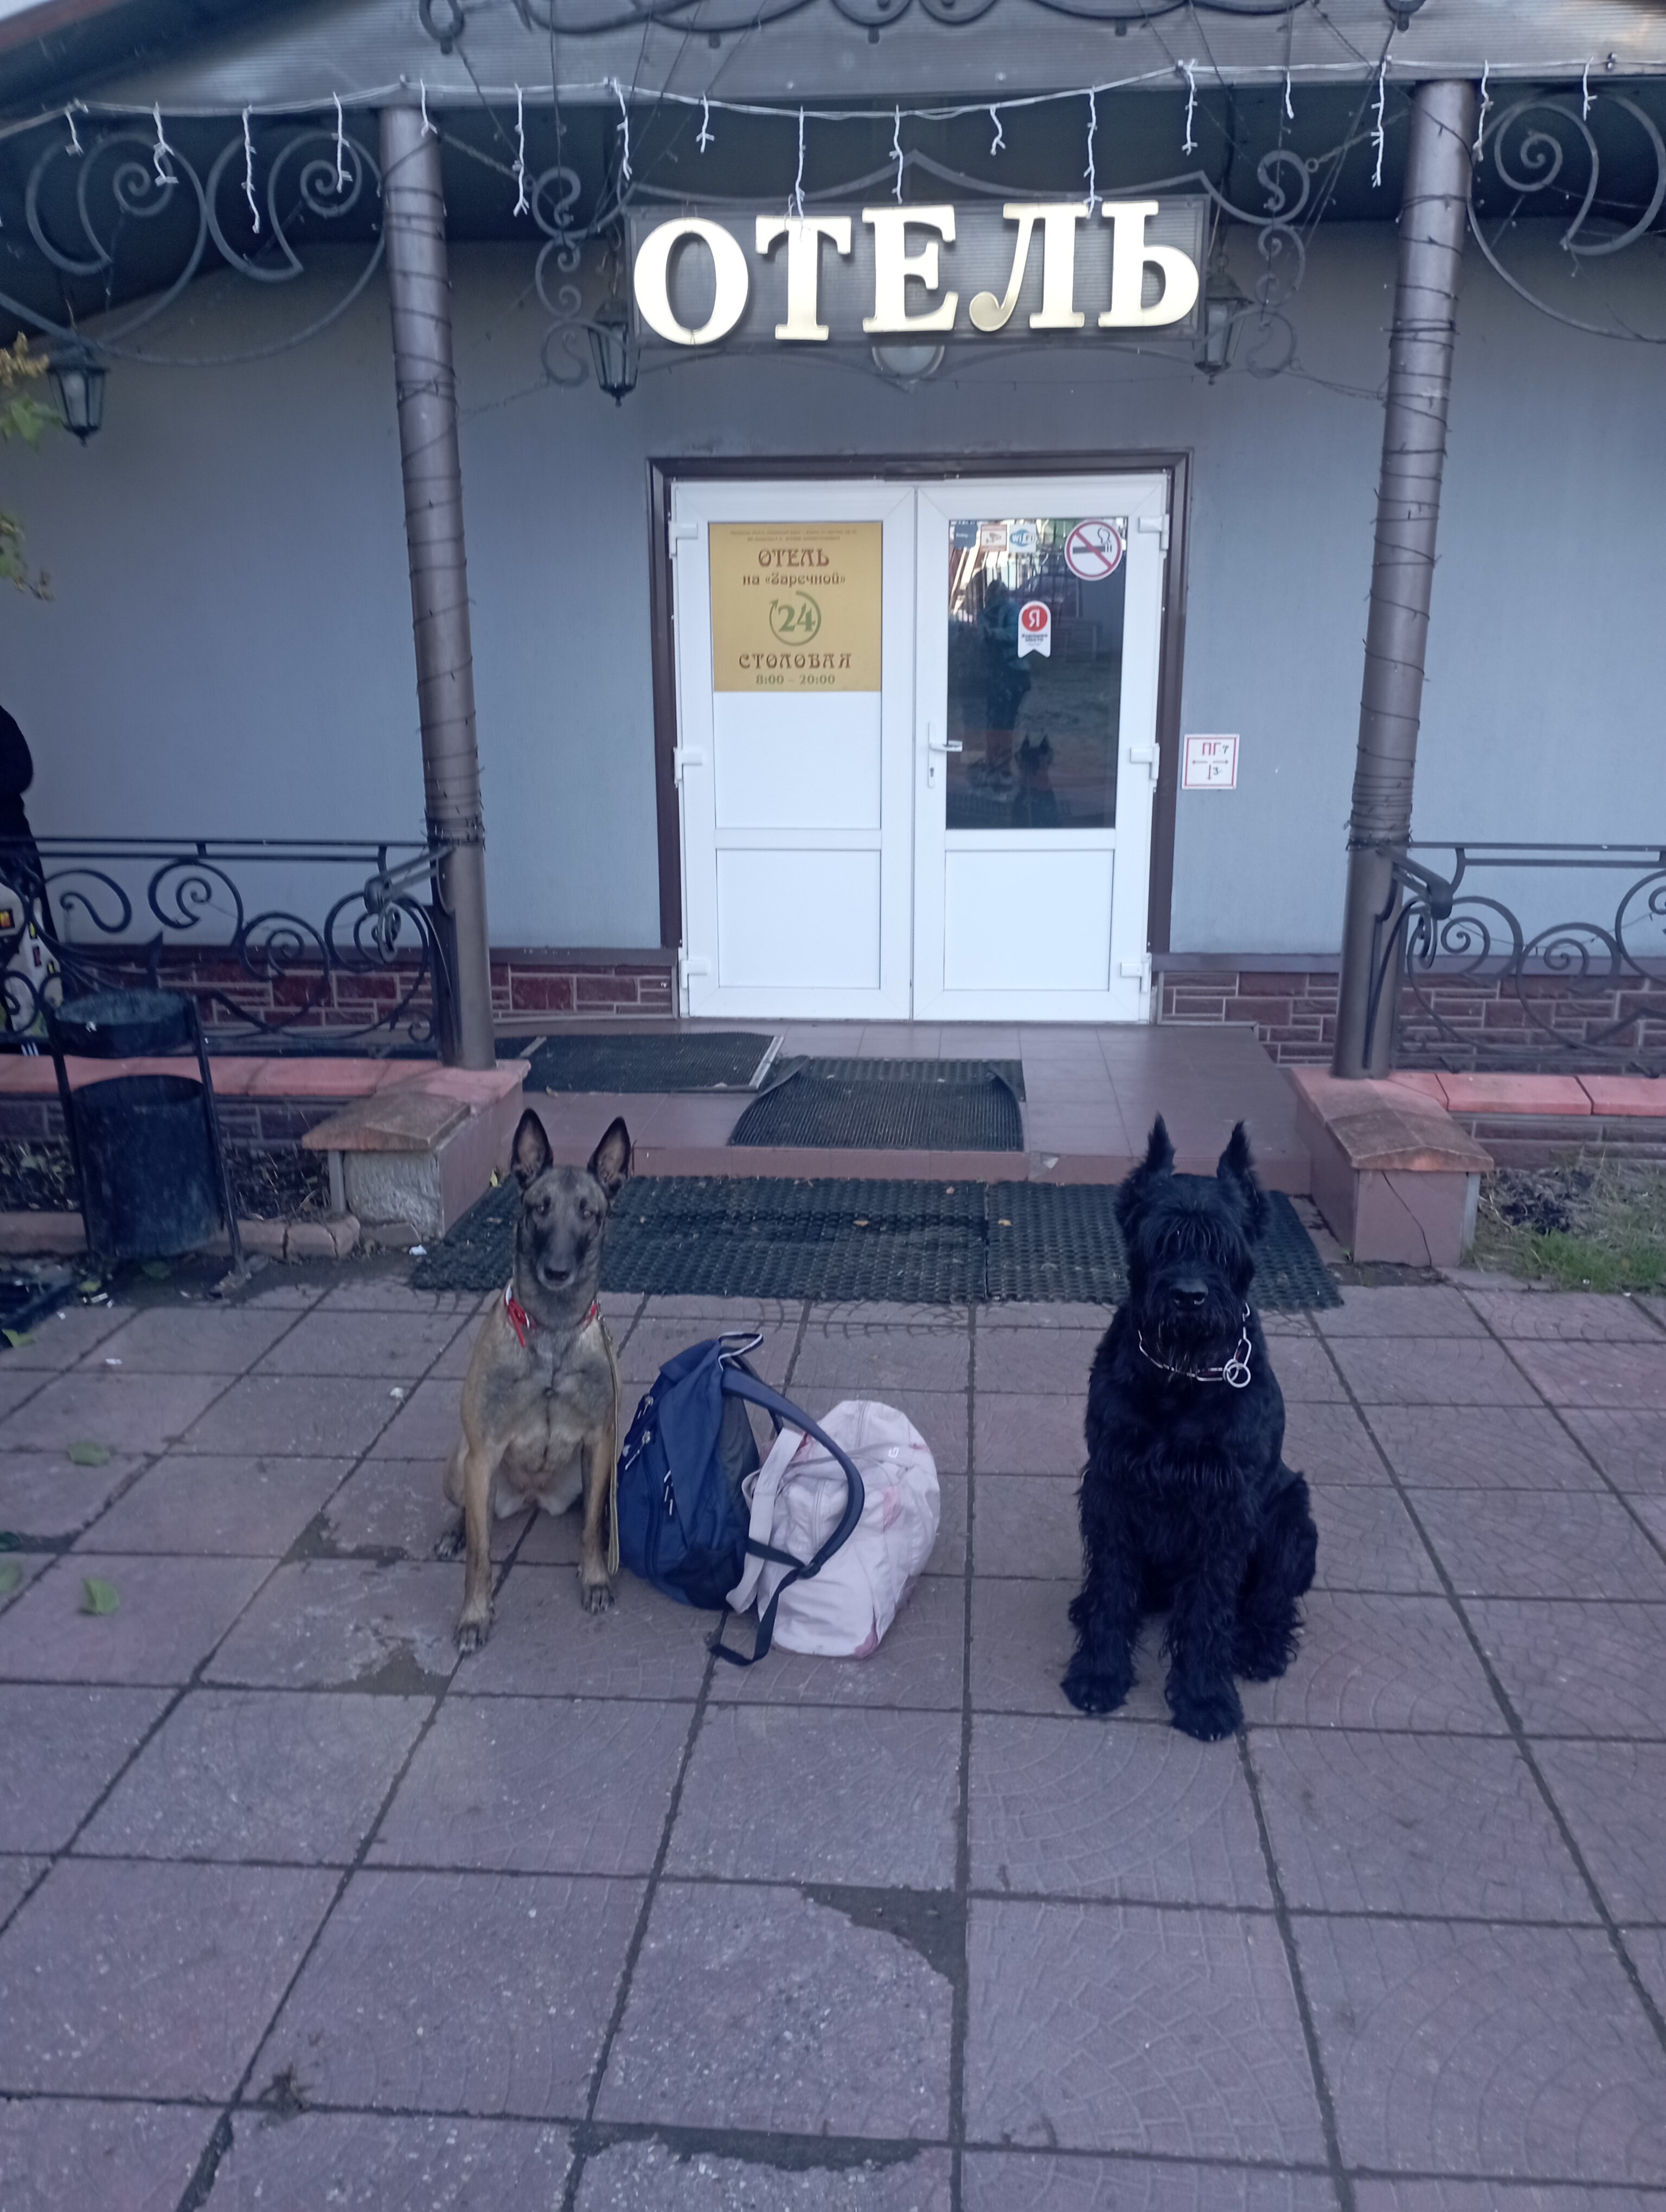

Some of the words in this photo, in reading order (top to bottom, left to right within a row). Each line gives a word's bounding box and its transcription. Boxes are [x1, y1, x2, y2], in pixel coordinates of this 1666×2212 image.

[633, 200, 1200, 345] ОТЕЛЬ
[758, 549, 830, 567] ОТЕЛЬ
[743, 574, 759, 586] на
[765, 572, 845, 587] «Заречной»
[778, 602, 816, 632] 24
[1029, 609, 1040, 627] Я
[739, 653, 851, 668] СТОЛОВАЯ
[756, 674, 784, 685] 8:00
[799, 674, 835, 685] 20:00
